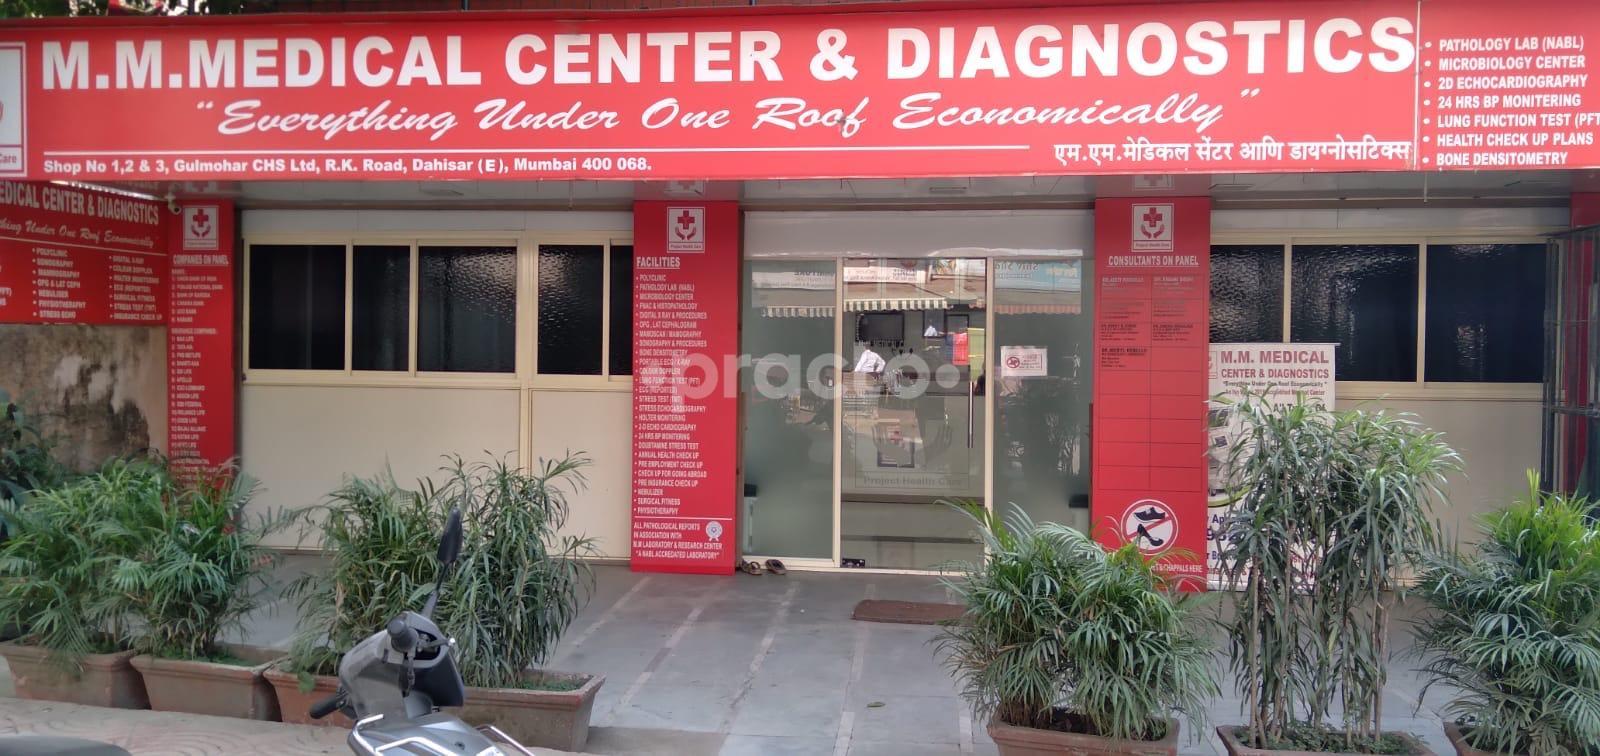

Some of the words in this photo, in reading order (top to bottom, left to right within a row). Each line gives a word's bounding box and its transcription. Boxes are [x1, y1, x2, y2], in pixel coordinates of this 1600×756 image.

[1439, 38, 1512, 51] PATHOLOGY
[1515, 37, 1539, 50] LAB
[1542, 35, 1584, 52] (NABL)
[42, 36, 481, 89] M.M.MEDICAL
[505, 30, 783, 85] CENTER
[810, 29, 858, 81] &
[888, 17, 1414, 79] DIAGNOSTICS
[1439, 56, 1532, 71] MICROBIOLOGY
[1536, 55, 1586, 69] CENTER
[1438, 77, 1454, 90] 2D
[1457, 74, 1588, 89] ECHOCARDIOGRAPHY
[1438, 96, 1452, 109] 24
[1455, 95, 1480, 108] HRS
[1484, 95, 1500, 108] BP
[1503, 93, 1582, 108] MONITERING
[474, 98, 620, 131] Under
[641, 97, 730, 130] One
[752, 97, 869, 138] Roof
[1437, 115, 1470, 128] LUNG
[1474, 114, 1537, 128] FUNCTION
[1540, 113, 1571, 127] TEST
[1437, 134, 1483, 147] HEALTH
[1486, 133, 1529, 146] CHECK
[1532, 133, 1549, 145] UP
[1553, 132, 1594, 145] PLANS
[1195, 136, 1233, 161] सेंटर
[1240, 135, 1283, 161] आणि
[44, 159, 81, 174] Shop
[86, 160, 106, 172] No
[111, 160, 134, 174] 1,2
[139, 160, 151, 172] &
[156, 160, 170, 174] 3,
[174, 159, 248, 172] Gulmohar
[252, 159, 286, 172] CHS
[290, 158, 320, 173] Ltd,
[325, 159, 357, 171] R.K.
[363, 158, 408, 173] Road,
[412, 158, 474, 171] Dahisar
[477, 158, 509, 173] (E),
[514, 158, 577, 171] Mumbai
[581, 158, 614, 171] 400
[616, 158, 652, 171] 068.
[1436, 153, 1469, 166] BONE
[1473, 151, 1568, 166] DENSITOMETRY
[42, 189, 85, 215] CENTER
[87, 194, 95, 217] &
[97, 196, 159, 225] DIAGNOSTICS
[25, 220, 55, 236] Under
[59, 225, 76, 237] One
[80, 228, 100, 244] Roof
[637, 257, 680, 267] FACILITIES
[1108, 255, 1161, 266] CONSULTANTS
[1163, 255, 1174, 265] ON
[1175, 255, 1199, 266] PANEL
[1221, 351, 1254, 364] M.M.
[1260, 351, 1329, 364] MEDICAL
[1221, 369, 1256, 378] CENTER
[1260, 369, 1265, 378] &
[1268, 369, 1329, 378] DIAGNOSTICS
[634, 522, 642, 530] ALL
[679, 522, 700, 530] REPORTS
[704, 541, 722, 550] CENTER
